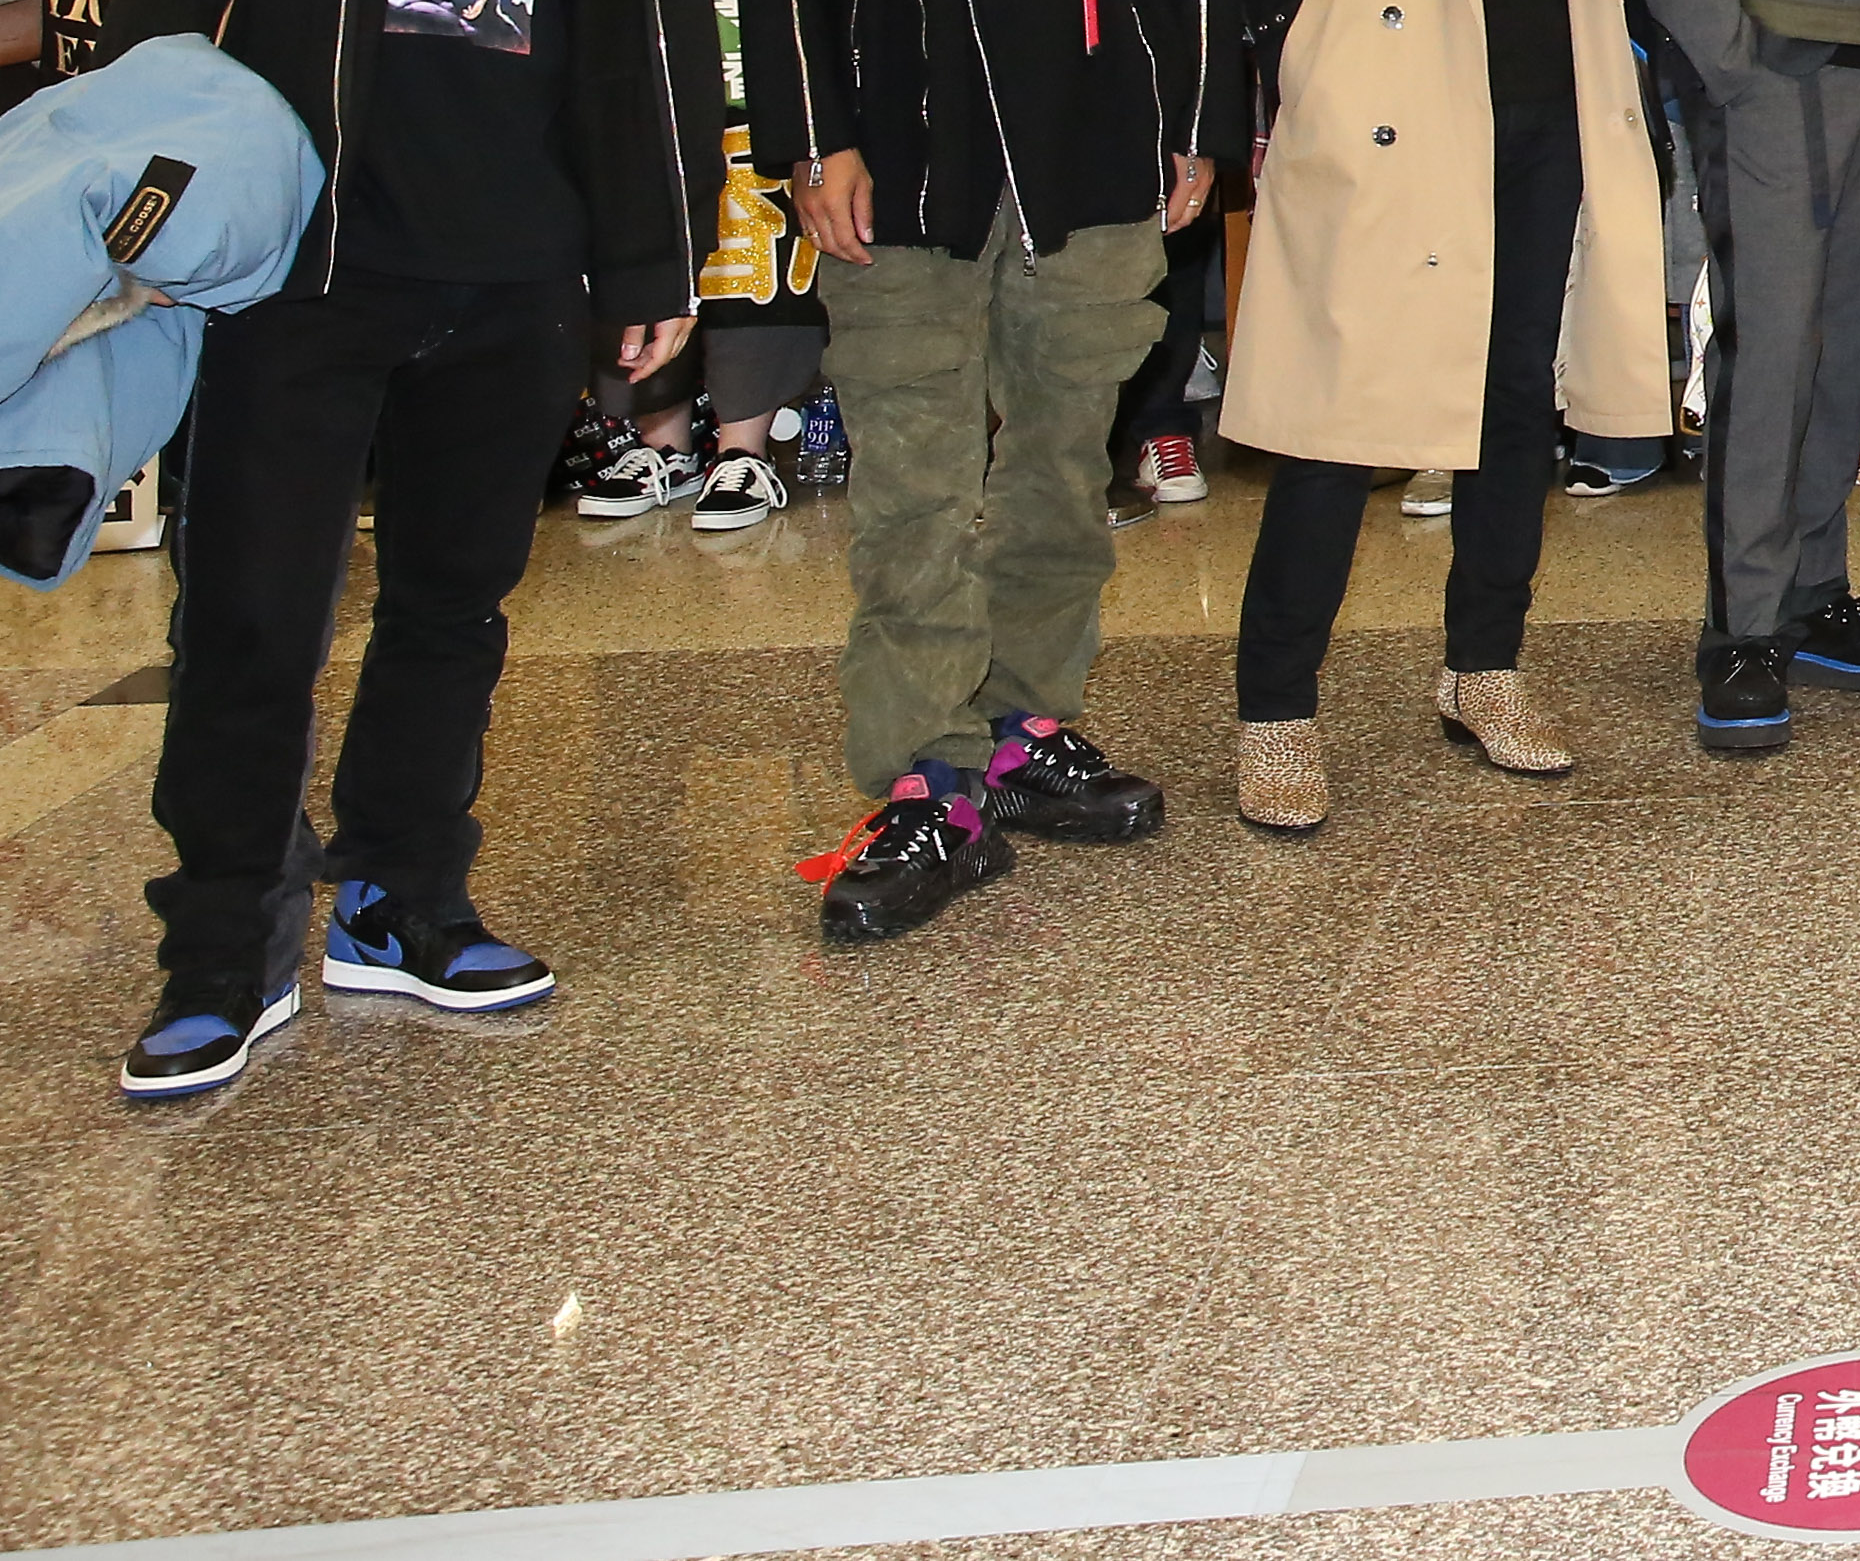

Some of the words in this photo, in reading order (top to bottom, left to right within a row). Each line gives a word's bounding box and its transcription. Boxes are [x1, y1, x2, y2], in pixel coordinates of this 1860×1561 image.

[129, 197, 158, 233] GOOSE
[807, 433, 829, 446] 9.0
[1766, 1393, 1804, 1444] Currency
[1759, 1444, 1799, 1503] Exchange
